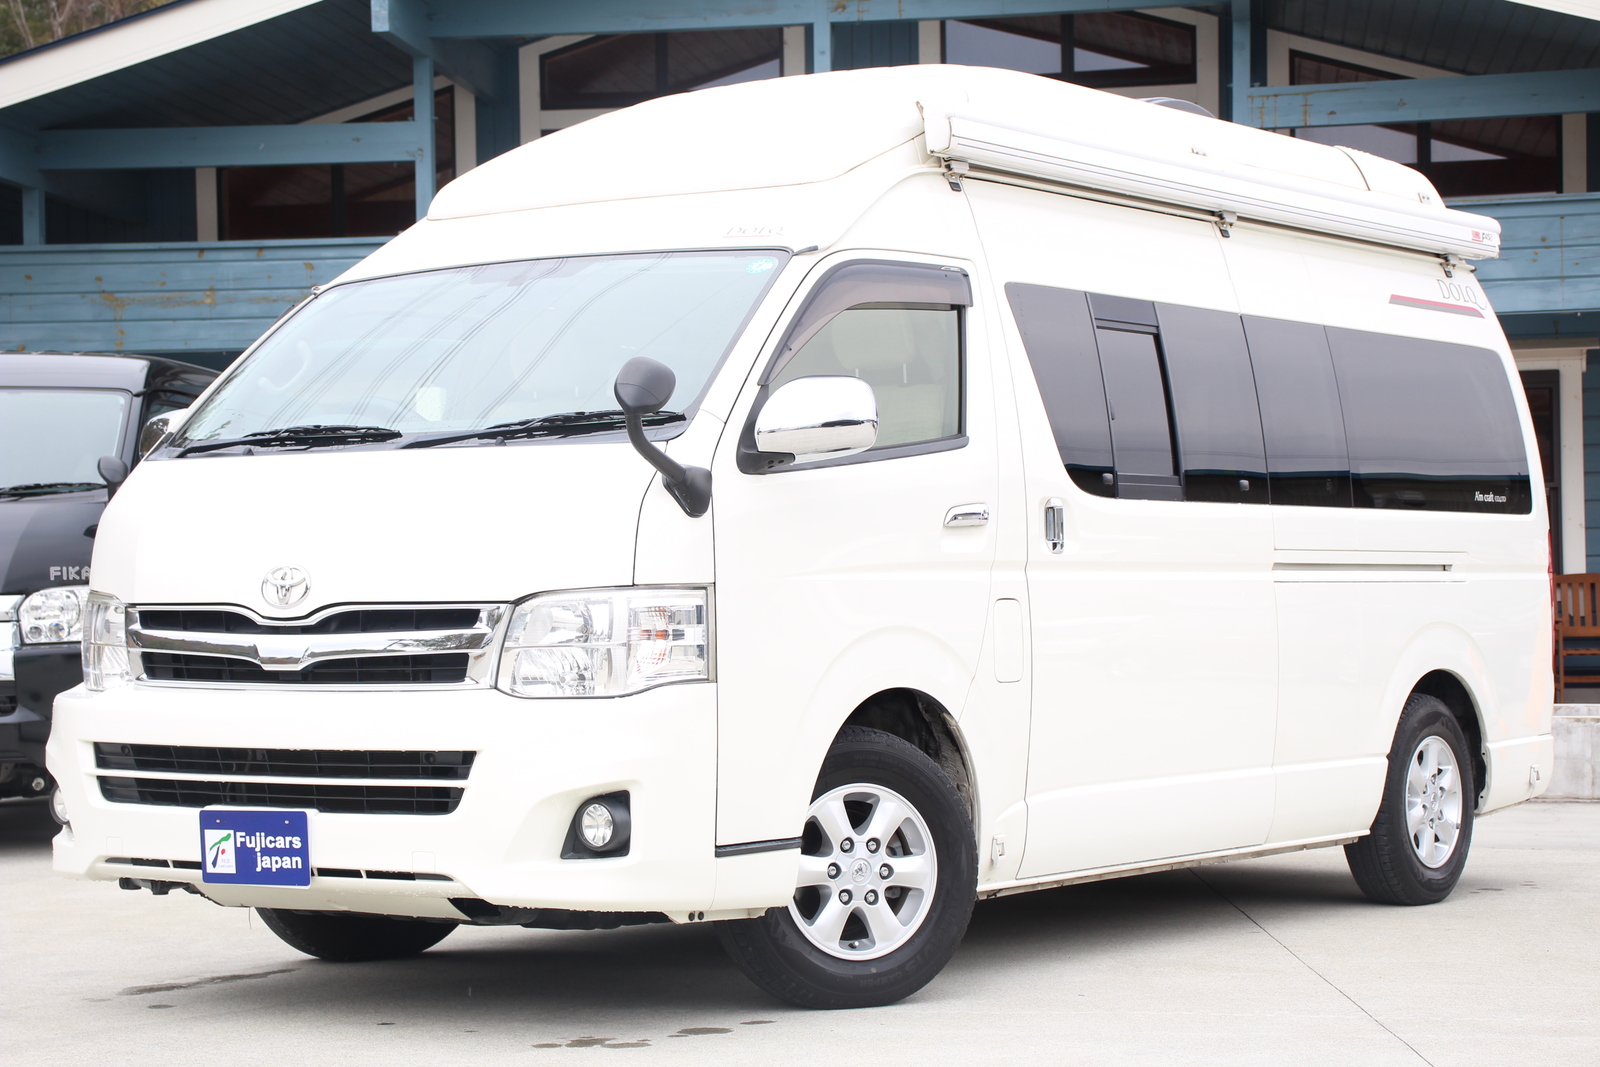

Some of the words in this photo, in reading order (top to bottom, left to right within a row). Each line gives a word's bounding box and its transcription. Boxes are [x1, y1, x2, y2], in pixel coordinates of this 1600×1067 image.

[1436, 279, 1487, 310] DOLQ
[50, 566, 91, 581] FIKA
[236, 832, 302, 852] Fujicars
[255, 852, 302, 872] japan
